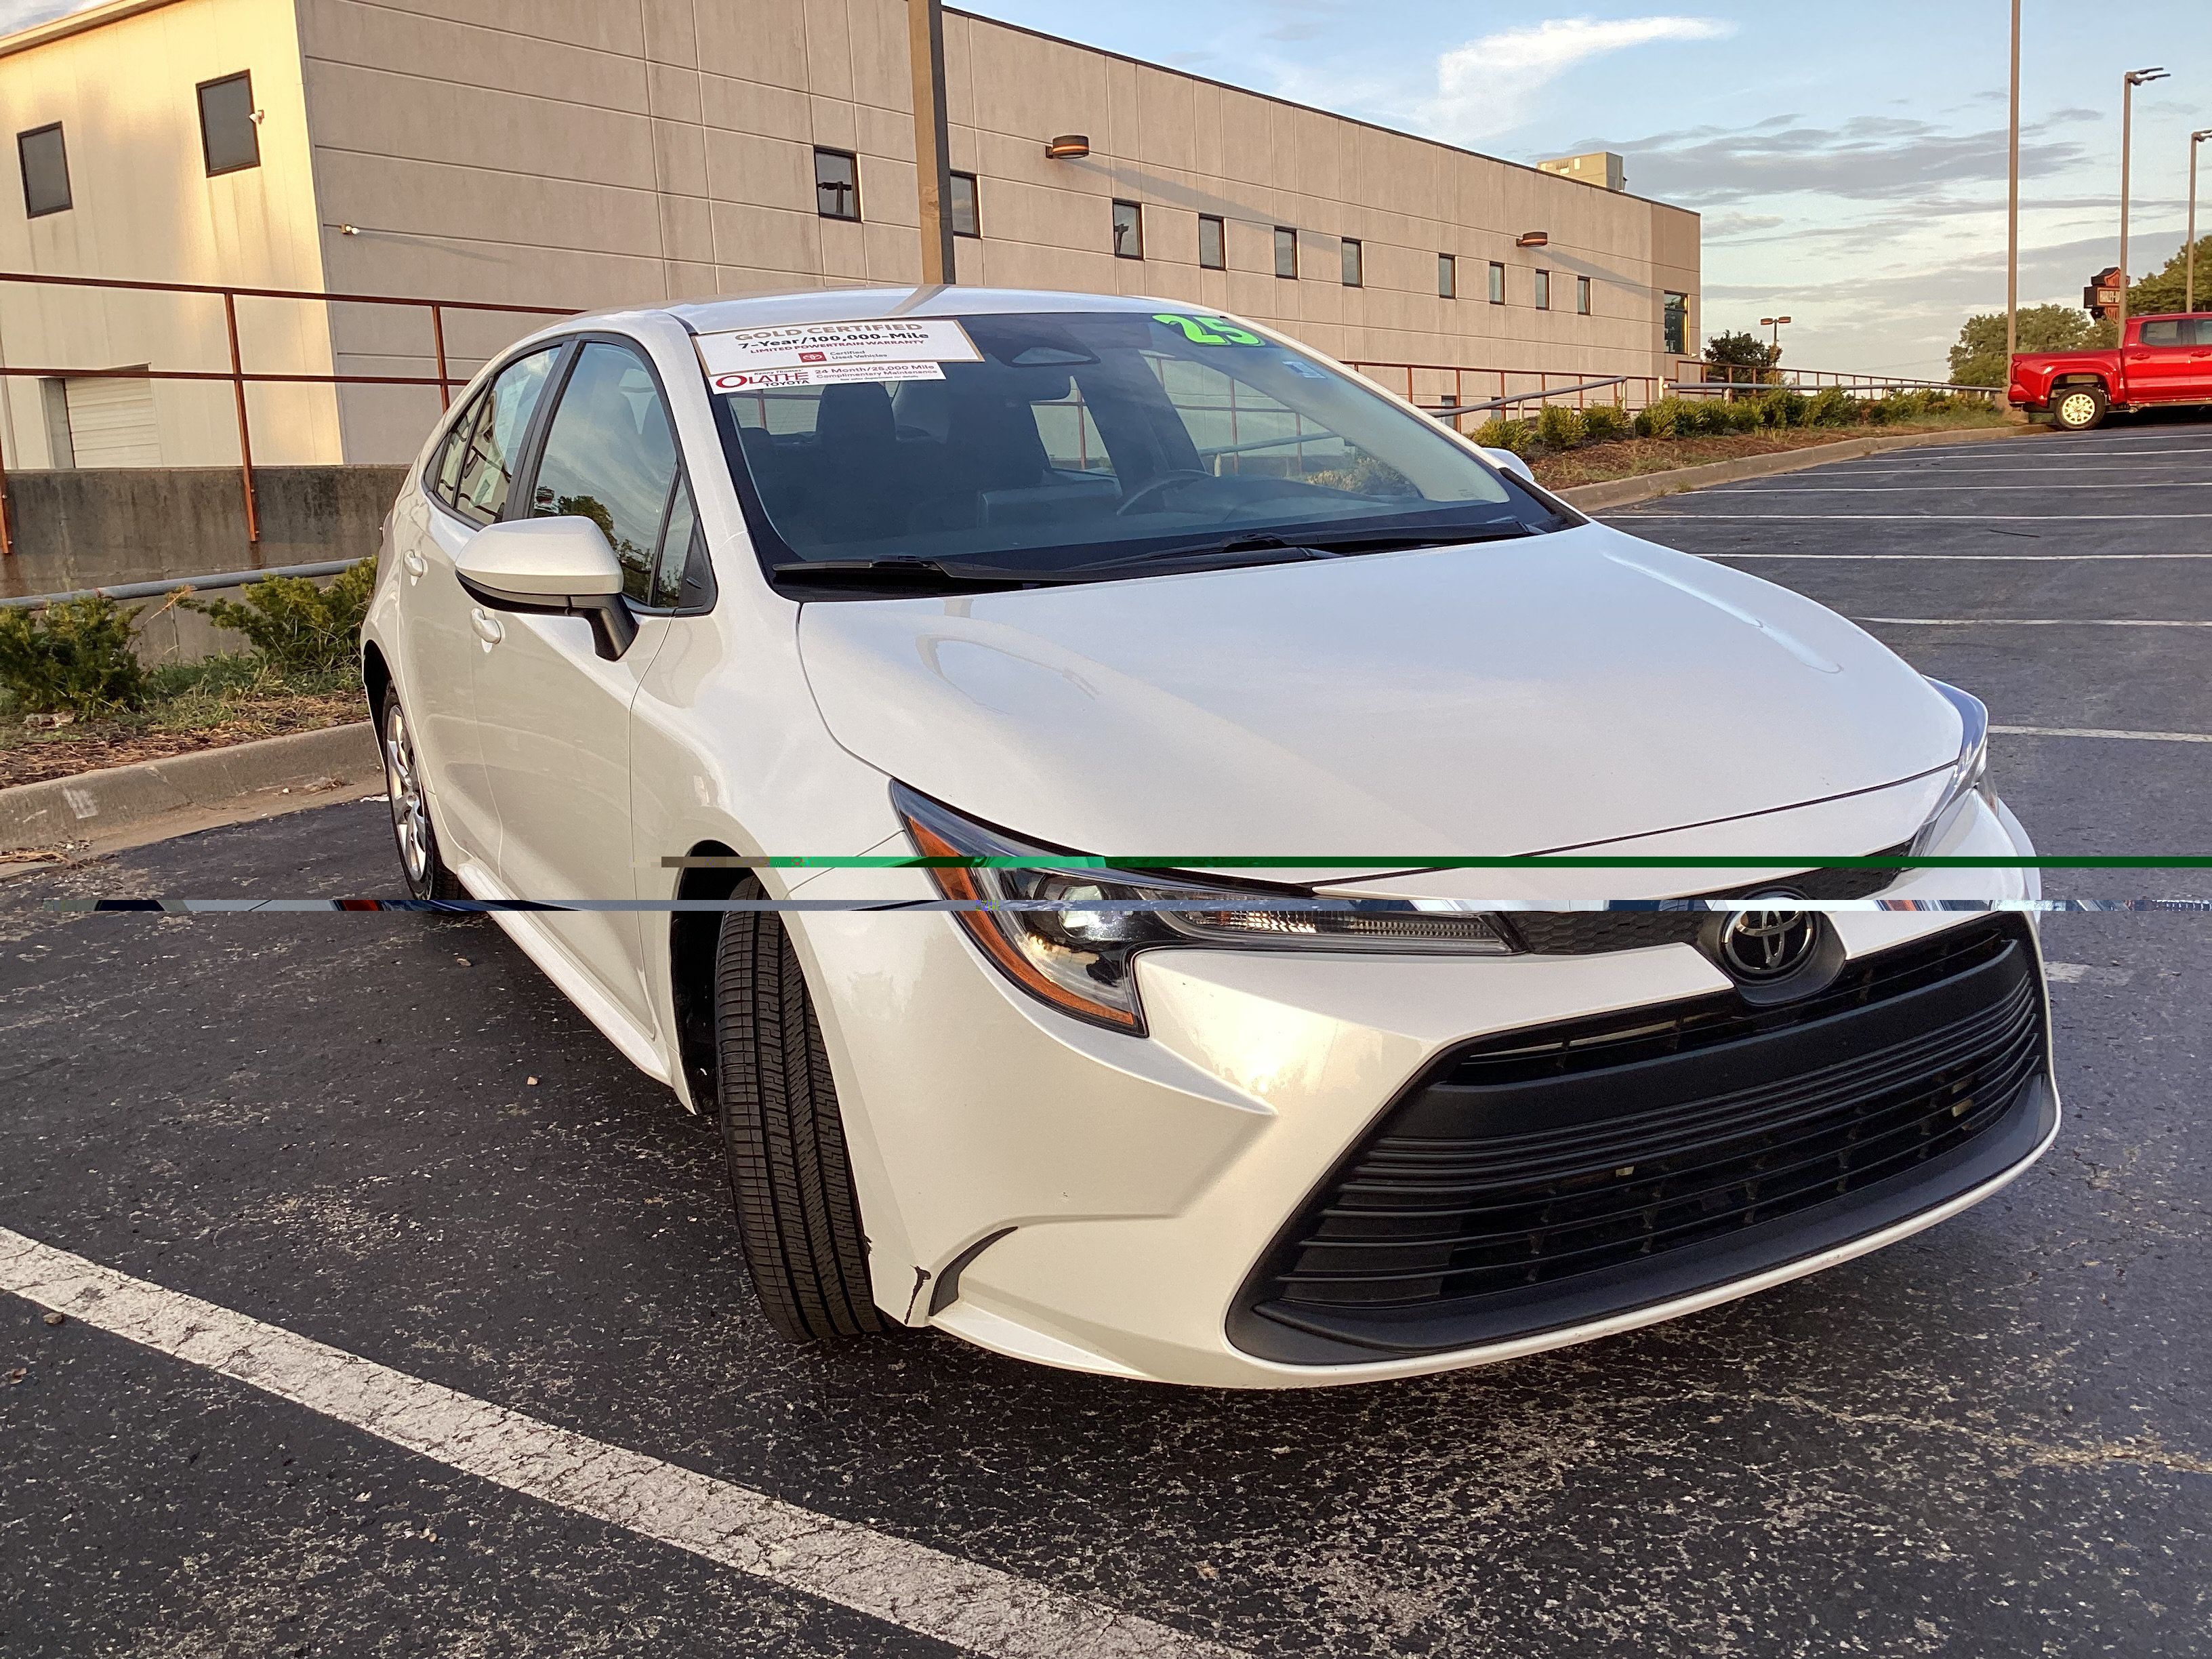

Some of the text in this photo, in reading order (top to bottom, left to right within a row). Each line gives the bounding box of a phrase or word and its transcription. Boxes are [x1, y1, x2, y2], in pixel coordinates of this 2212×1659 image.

[735, 324, 923, 341] GOLD CERTIFIED
[1152, 314, 1264, 346] 25
[738, 333, 929, 349] 7-Year/100,000-Mile
[750, 346, 793, 354] LIMITED
[794, 341, 865, 350] POWERTRAIN
[716, 372, 809, 388] OLATHE
